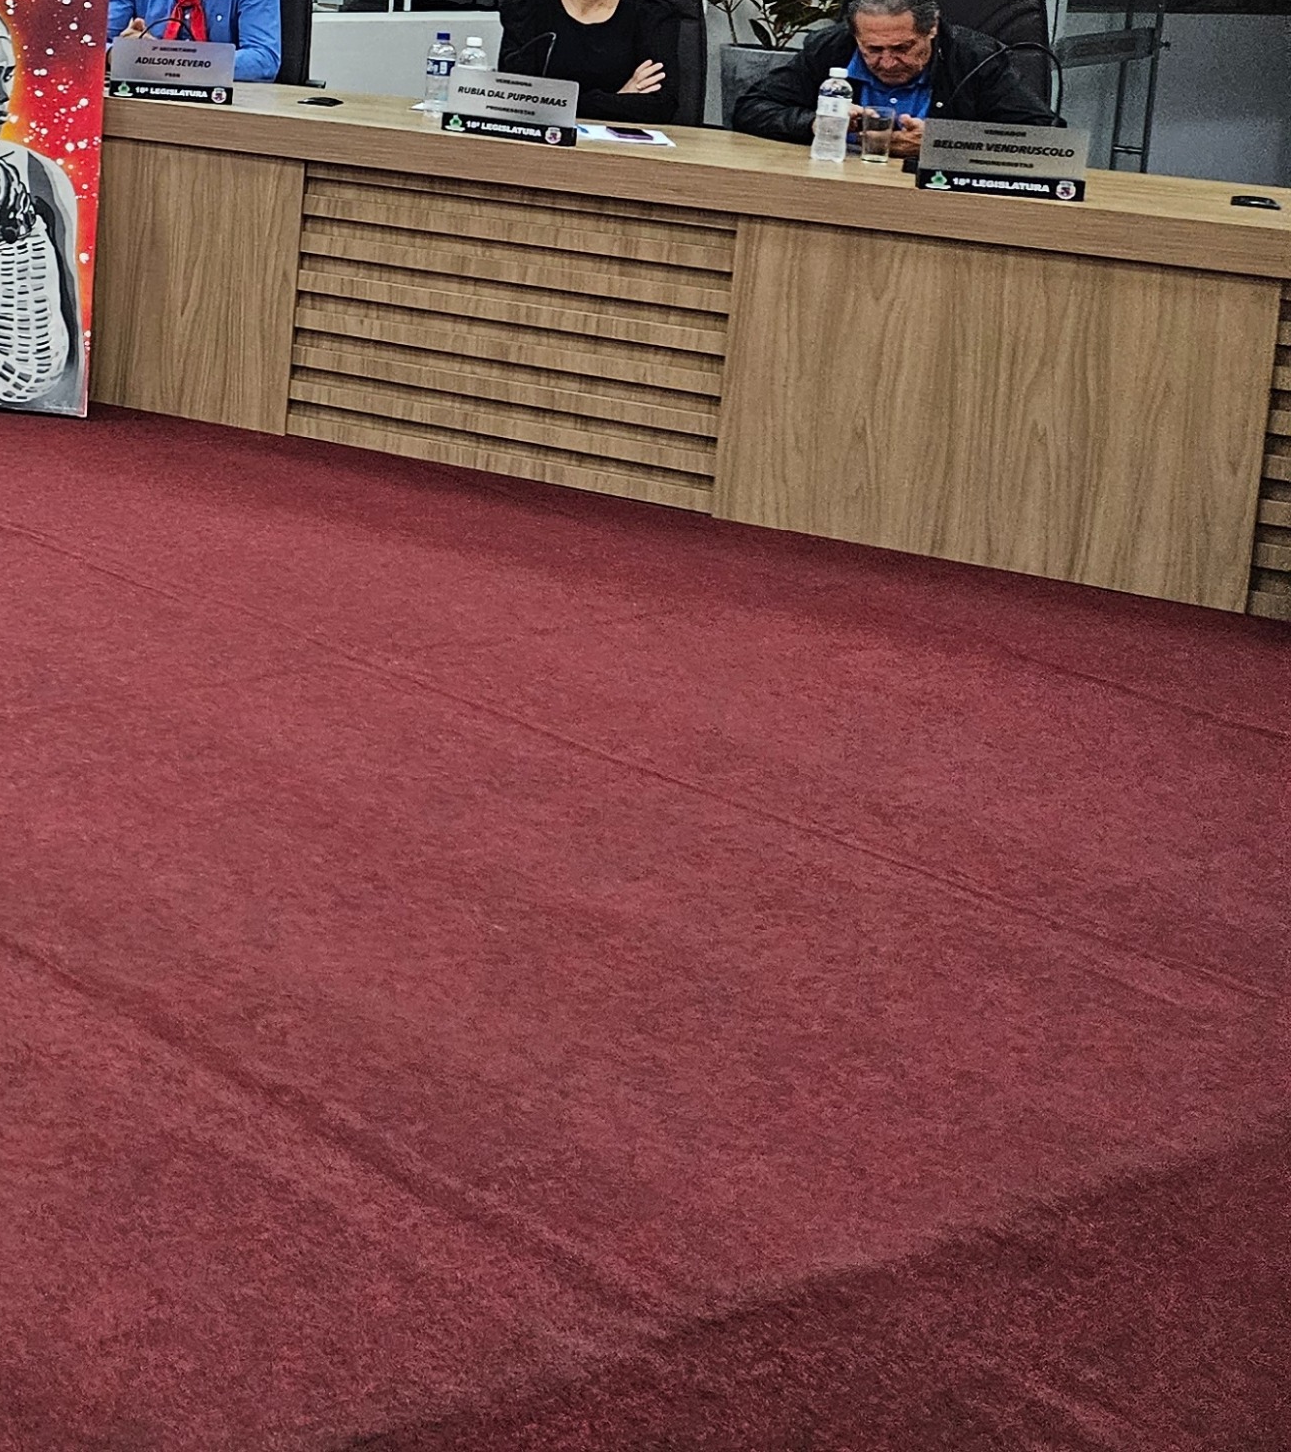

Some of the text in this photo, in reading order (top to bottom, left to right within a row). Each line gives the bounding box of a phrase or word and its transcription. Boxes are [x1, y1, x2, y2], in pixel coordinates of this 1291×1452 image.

[135, 56, 212, 68] ADILSON SEVERO
[149, 87, 208, 98] LEGISLATURA
[458, 85, 568, 107] RUBIA DAL PUPPO MAAS
[480, 123, 542, 137] LEGISLATURA
[985, 142, 1075, 158] VENDRUSCOLO
[971, 178, 1050, 193] LEGISLATURA
